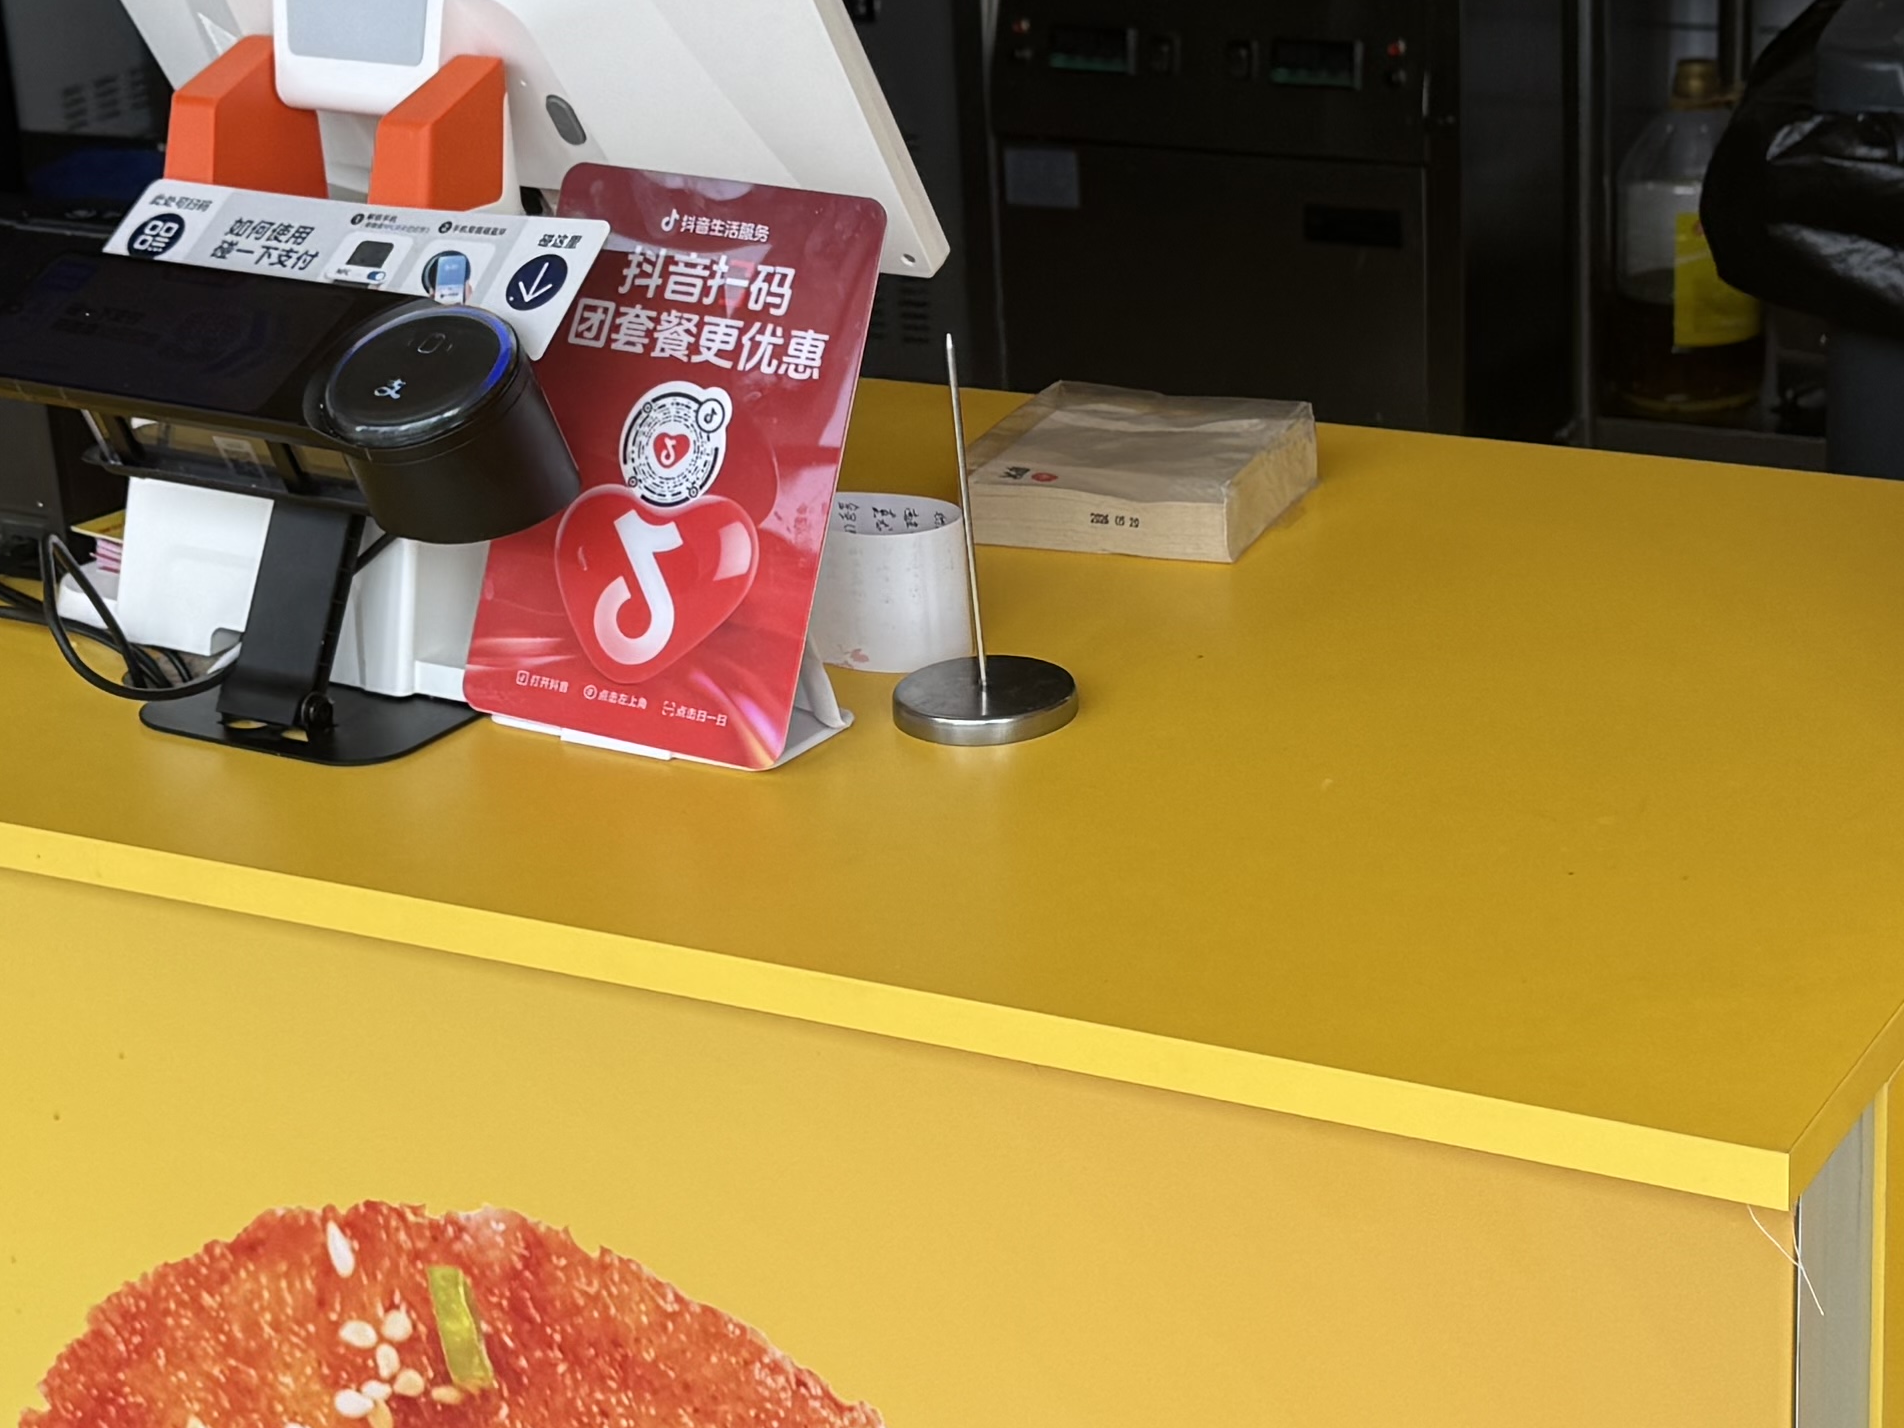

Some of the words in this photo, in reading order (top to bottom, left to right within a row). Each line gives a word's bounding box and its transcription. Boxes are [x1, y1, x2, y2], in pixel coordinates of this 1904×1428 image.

[225, 217, 315, 246] 如何使用
[537, 233, 583, 249] 碰这里
[680, 214, 770, 243] 抖音生活服务
[210, 240, 319, 271] 碰一下支付
[618, 245, 796, 317] 抖音扫码
[568, 297, 829, 380] 团套餐更优惠
[529, 675, 569, 693] 打开抖音
[598, 689, 648, 710] 点击左上角
